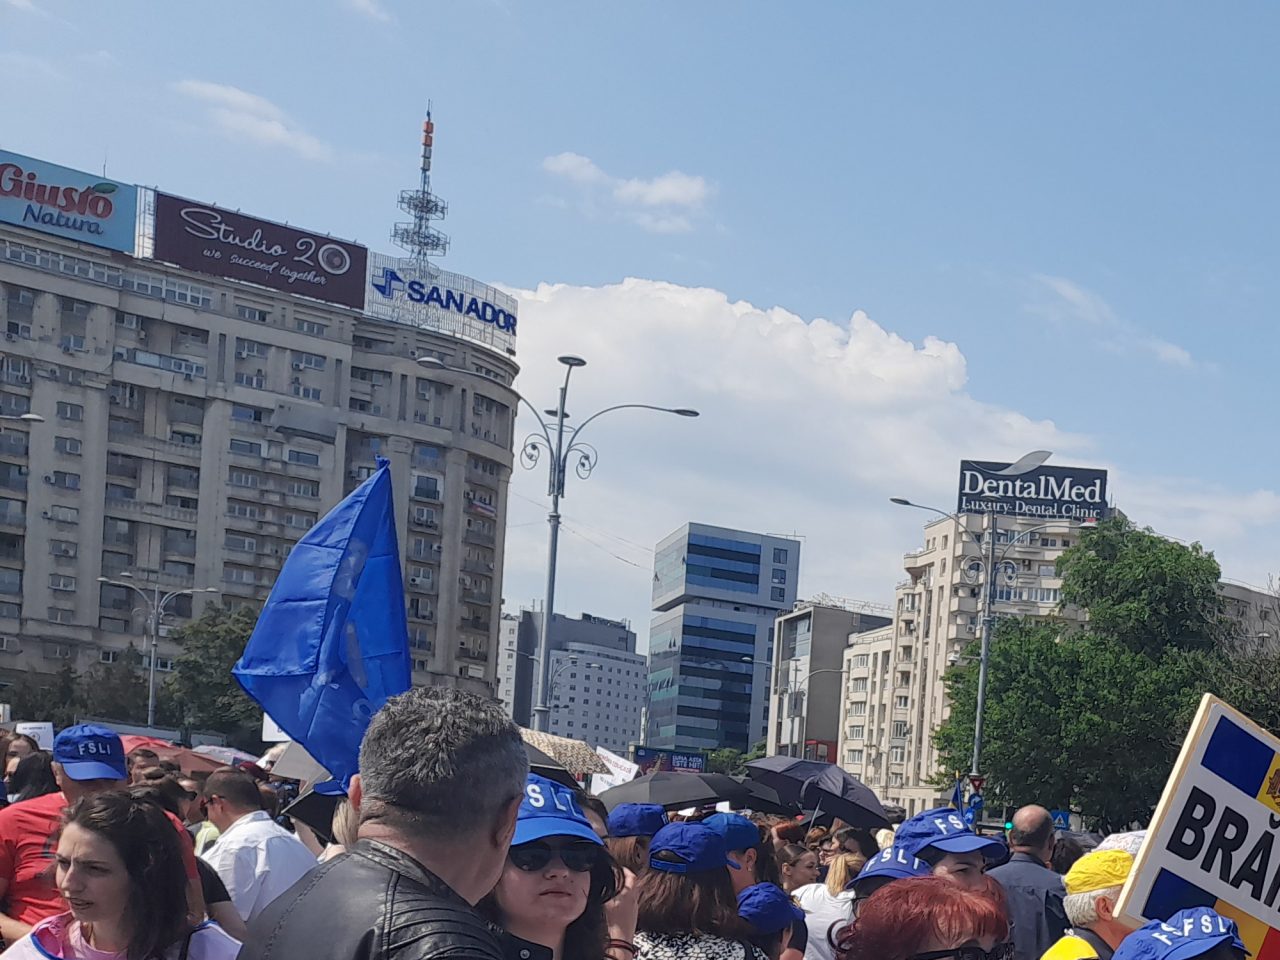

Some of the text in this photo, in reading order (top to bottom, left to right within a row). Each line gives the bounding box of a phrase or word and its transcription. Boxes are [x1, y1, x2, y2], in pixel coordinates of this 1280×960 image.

[0, 163, 113, 219] Giusto
[23, 204, 104, 235] Natura
[180, 207, 351, 275] Studio 20
[203, 248, 328, 286] we succeed together
[407, 280, 518, 337] SANADOR
[961, 470, 1102, 503] DentalMed
[1015, 500, 1058, 516] Dental
[1061, 503, 1101, 518] Clinic
[78, 741, 112, 756] FSLI
[526, 783, 579, 817] SLI
[865, 848, 920, 872] FSLI
